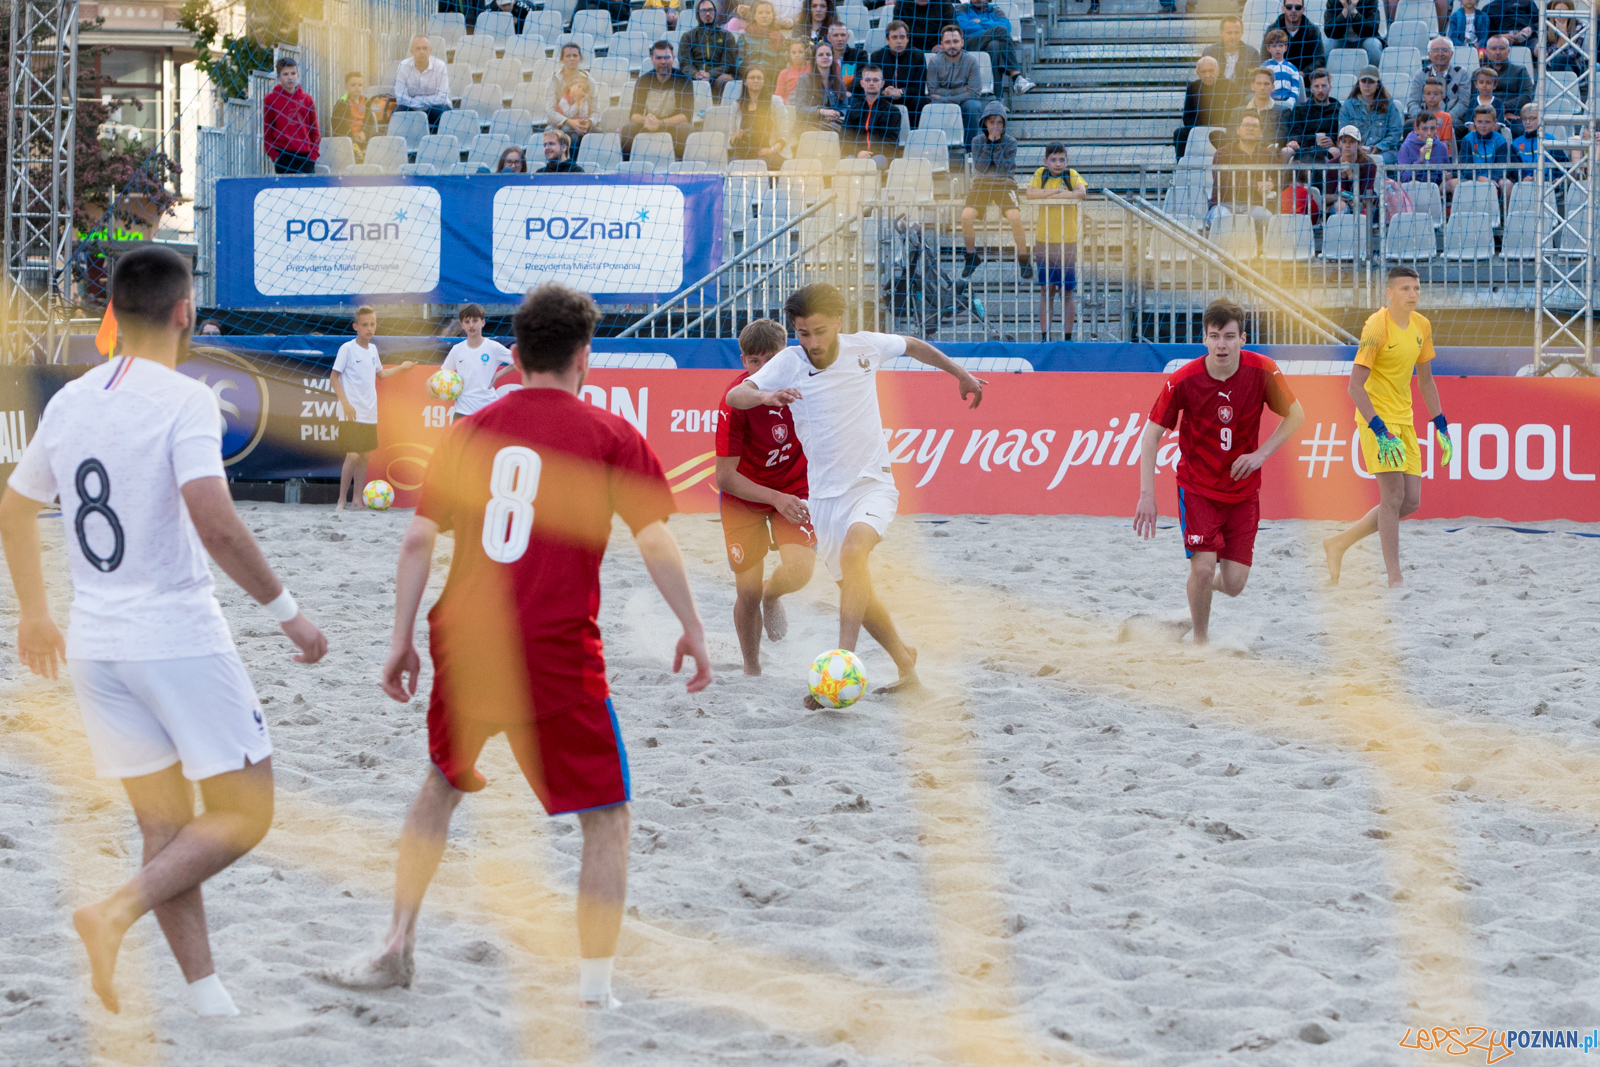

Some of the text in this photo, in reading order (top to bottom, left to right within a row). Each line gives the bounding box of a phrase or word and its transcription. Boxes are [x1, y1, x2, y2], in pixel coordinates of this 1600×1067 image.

[286, 262, 400, 273] Prezydenta Miasta Poznania
[525, 261, 641, 272] Prezydenta Miasta Poznania
[959, 427, 1057, 473] nas
[1220, 427, 1233, 451] 9
[74, 458, 125, 573] 8
[482, 445, 543, 564] 8
